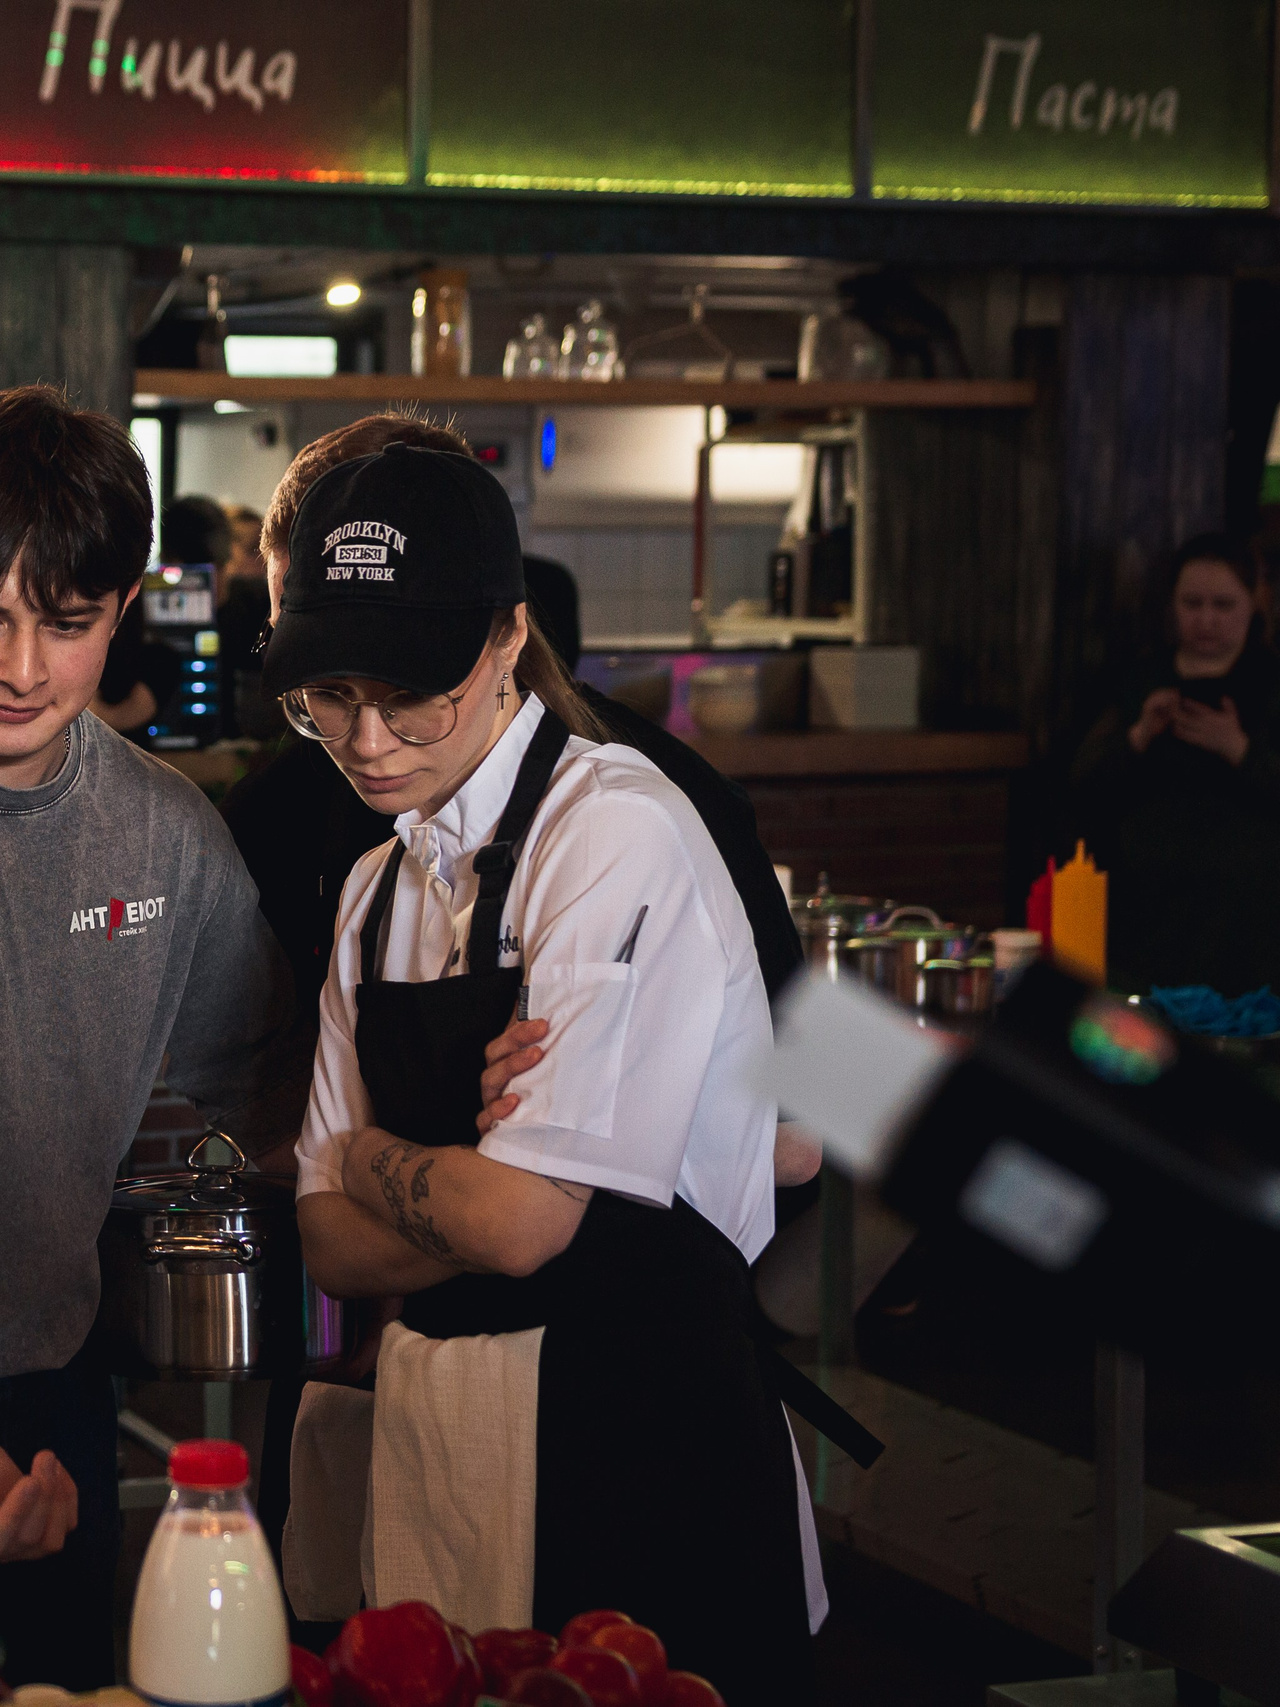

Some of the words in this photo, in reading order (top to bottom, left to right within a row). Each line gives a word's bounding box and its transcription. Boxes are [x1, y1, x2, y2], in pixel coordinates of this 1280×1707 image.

[38, 0, 297, 112] Пицца
[968, 32, 1179, 140] Паста
[321, 521, 408, 556] BROOKLYN
[326, 566, 354, 581] NEW
[357, 566, 396, 582] YORK
